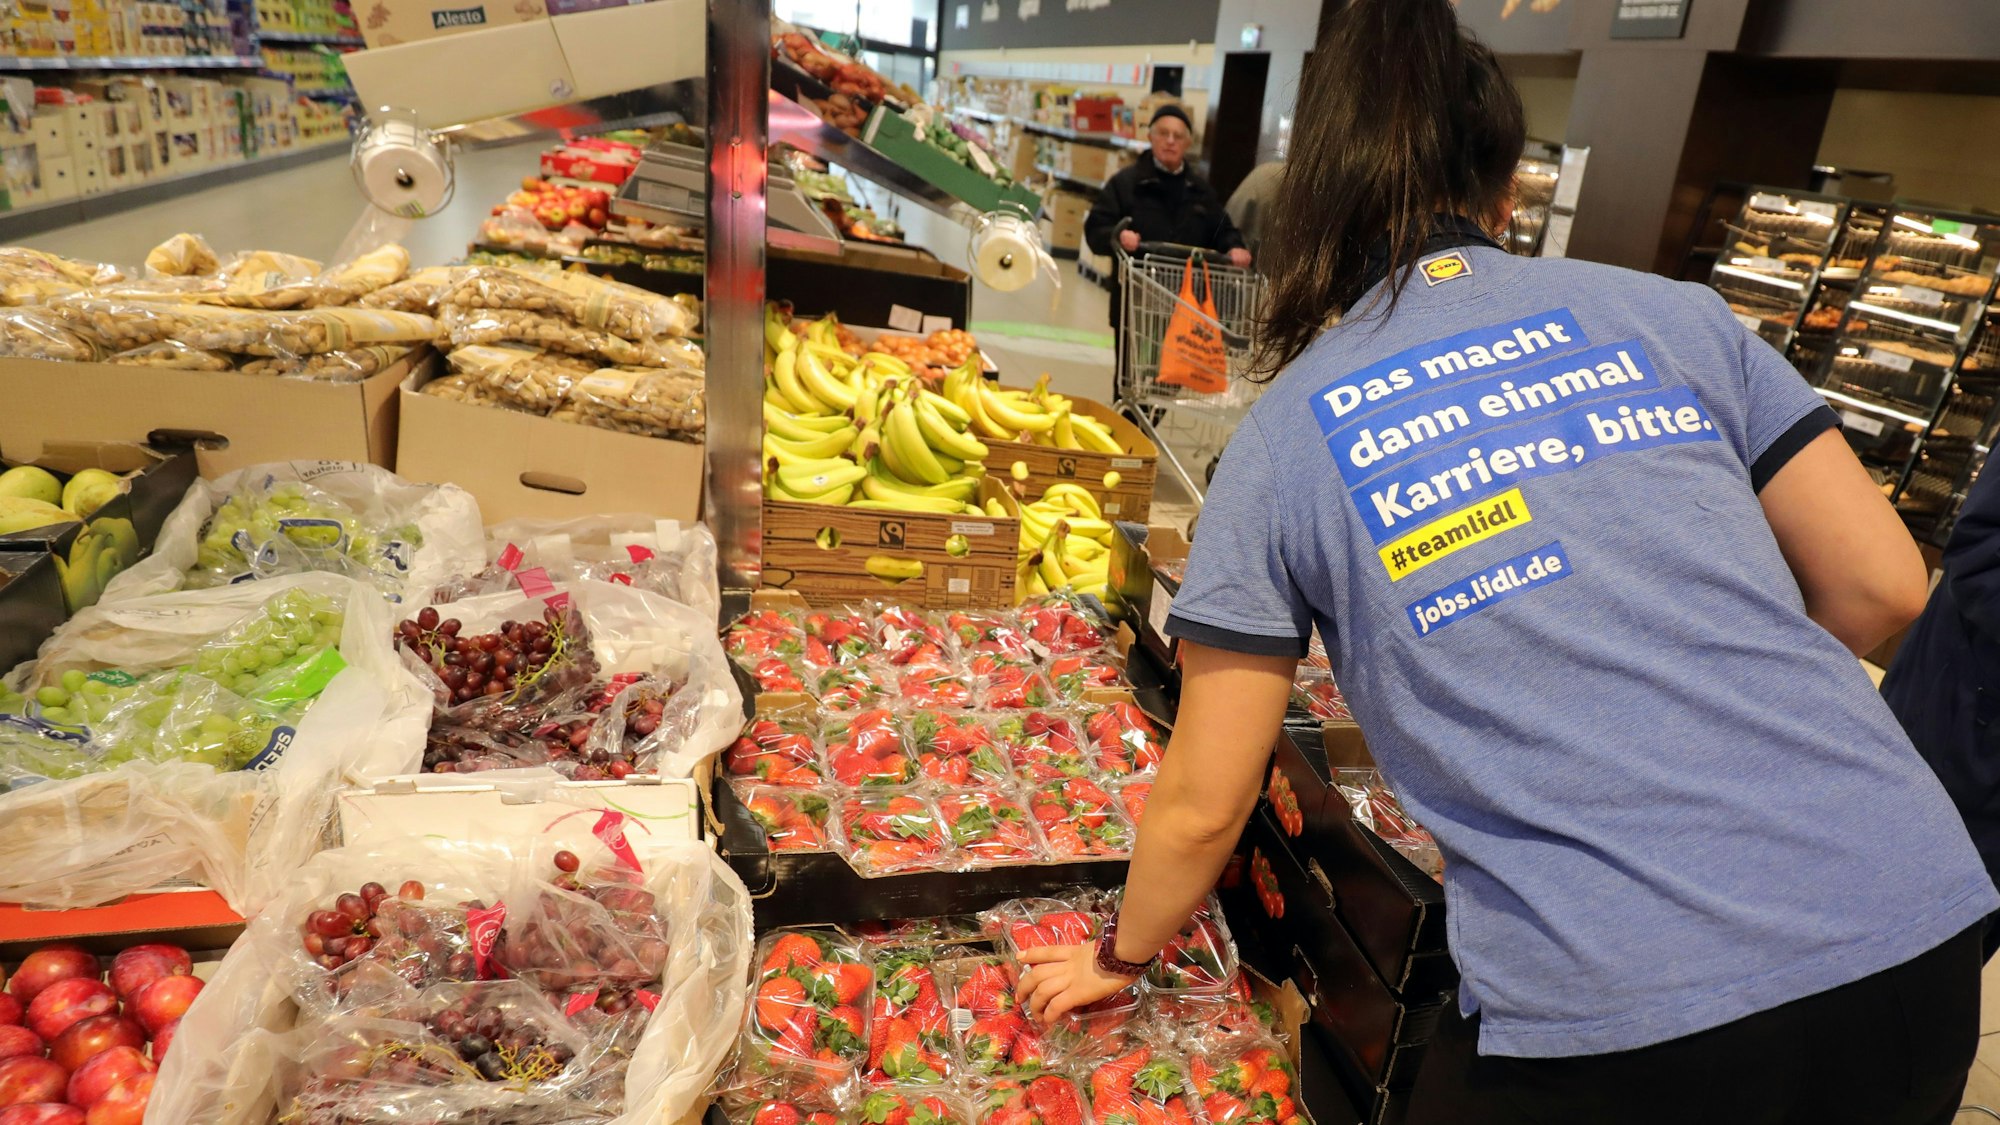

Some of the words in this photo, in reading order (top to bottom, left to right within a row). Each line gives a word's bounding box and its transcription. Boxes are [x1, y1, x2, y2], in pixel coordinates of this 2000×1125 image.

[436, 11, 482, 26] Alesto
[1323, 367, 1414, 418] Das
[1420, 321, 1572, 380] macht
[1349, 404, 1471, 468] dann
[1478, 350, 1644, 418] einmal
[1370, 437, 1585, 528] Karriere,
[1586, 403, 1713, 445] bitte.
[1391, 500, 1517, 571] #teamlidl
[1414, 554, 1563, 634] jobs.lidl.de
